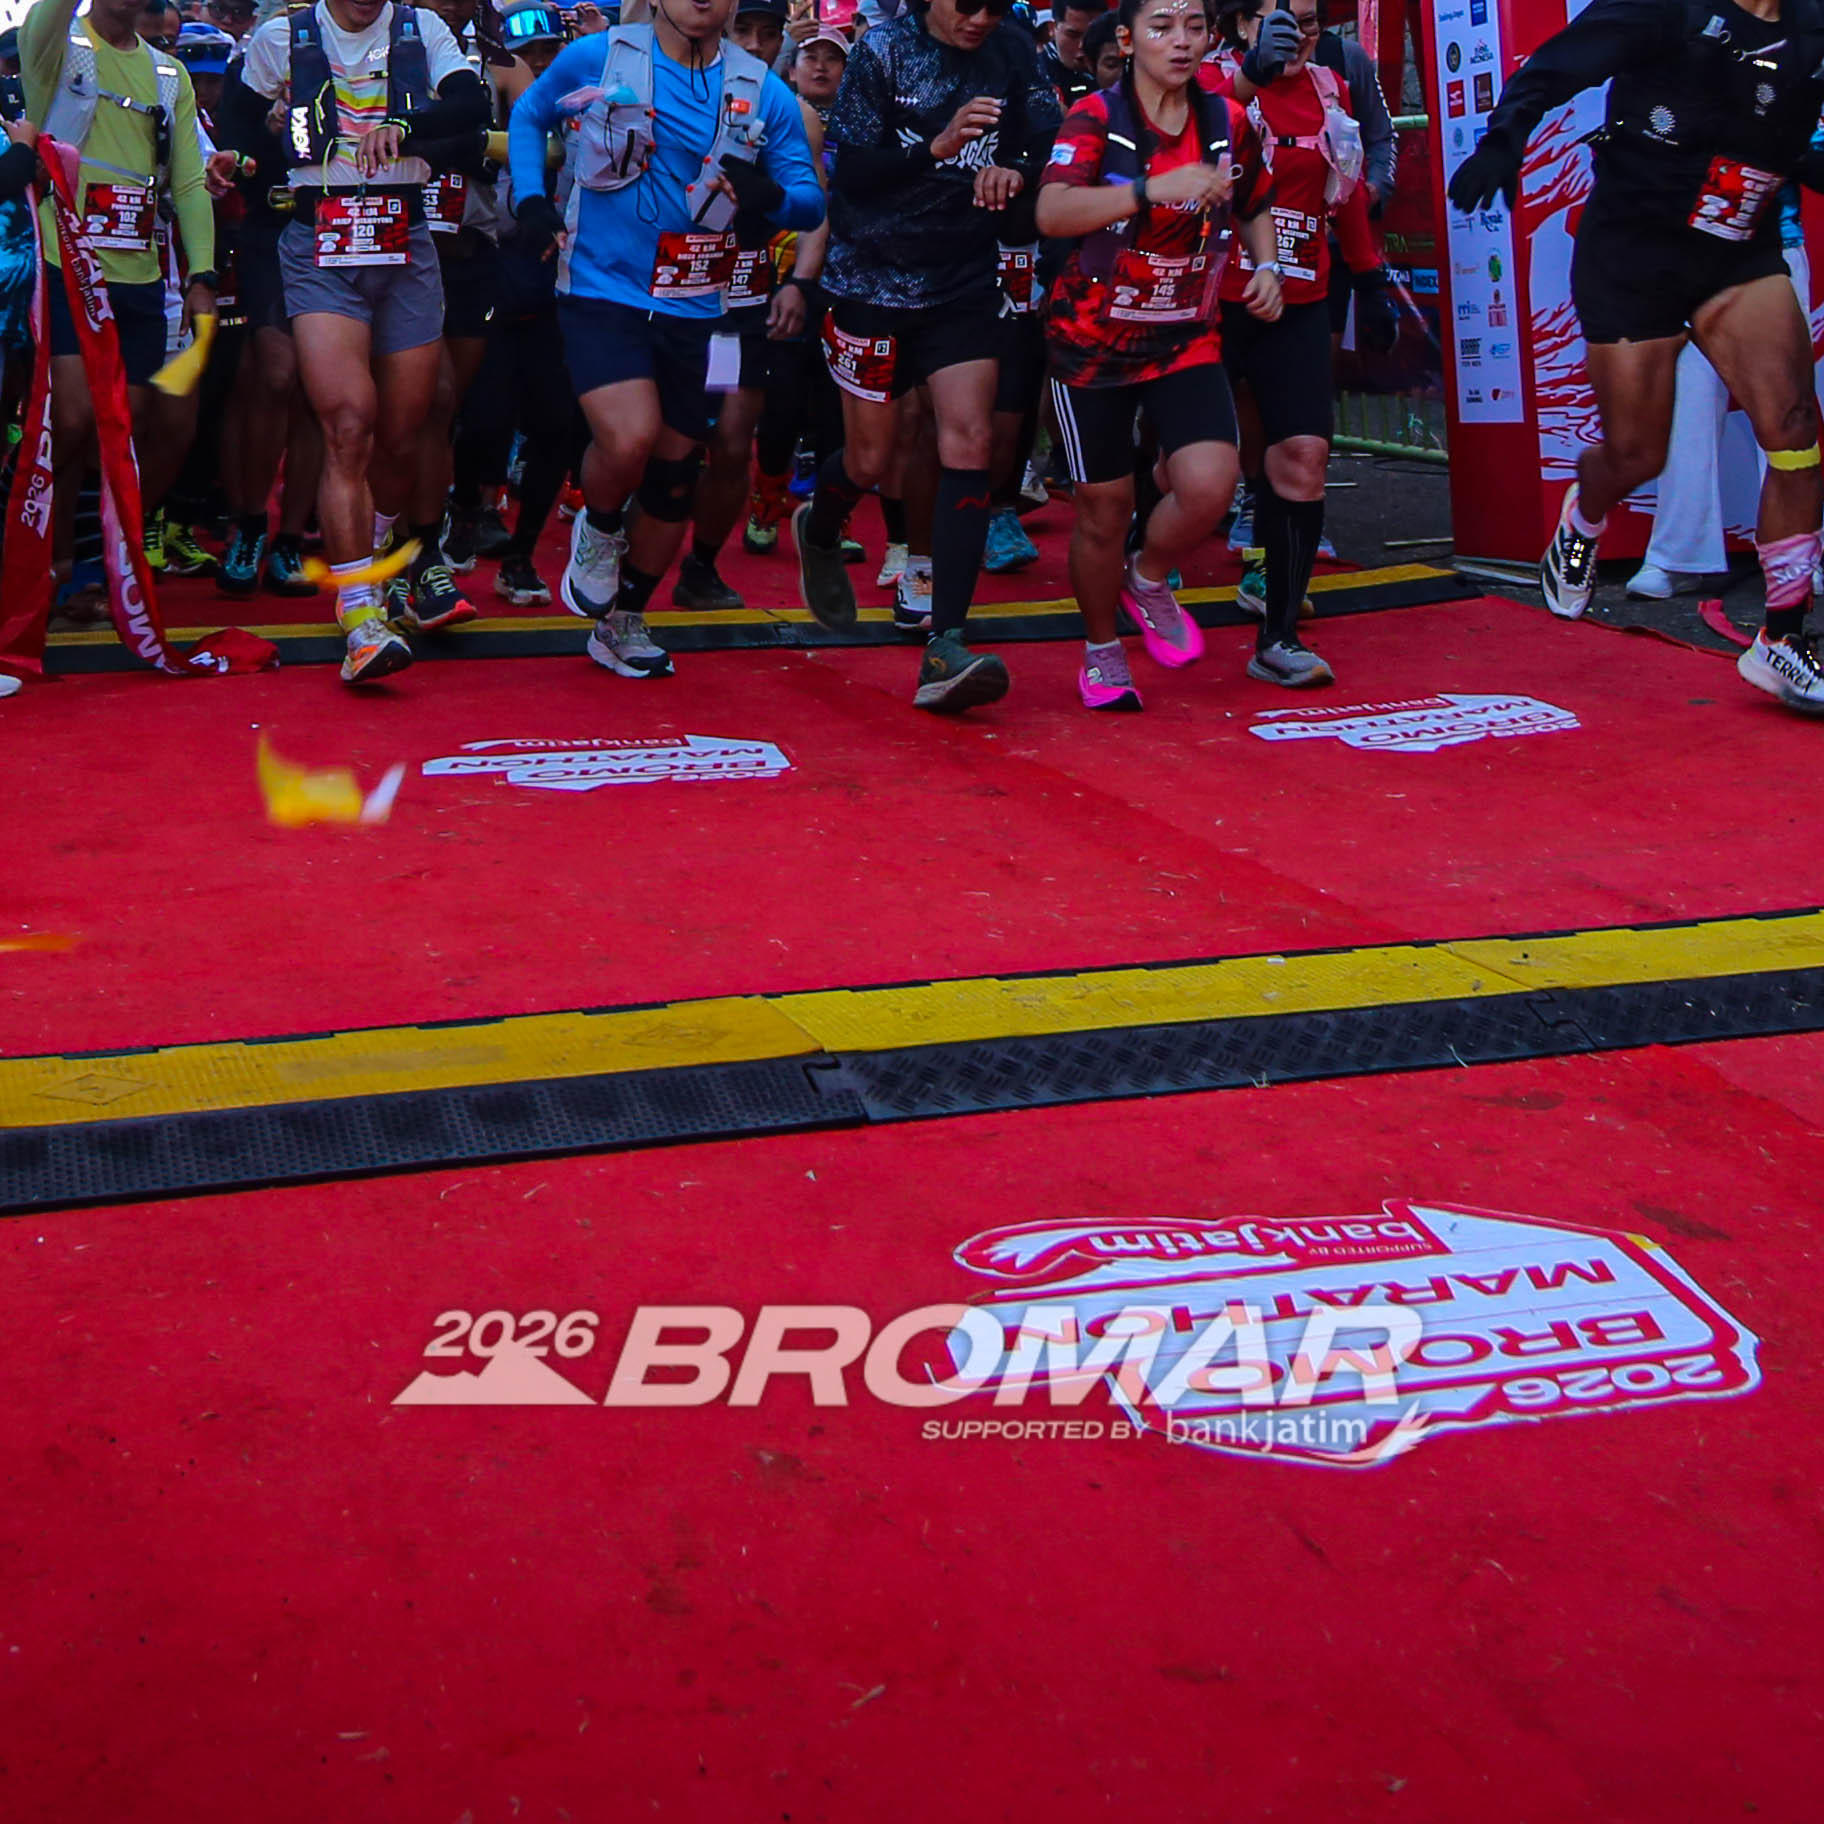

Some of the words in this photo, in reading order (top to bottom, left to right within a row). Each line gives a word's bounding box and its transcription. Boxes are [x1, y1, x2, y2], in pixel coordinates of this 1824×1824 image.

[119, 210, 137, 223] 102
[352, 225, 375, 238] 120
[1277, 234, 1296, 249] 267
[690, 260, 710, 272] 152
[732, 274, 748, 285] 147
[1152, 284, 1176, 296] 145
[837, 353, 857, 371] 261
[1275, 701, 1532, 735] MARATHON
[1358, 712, 1556, 743] BROMO
[448, 748, 764, 770] MARATHON
[527, 761, 767, 779] BROMO
[1089, 1215, 1423, 1257] bankjatim
[996, 1254, 1615, 1352] MARATHON
[1180, 1306, 1668, 1392] BROMO
[1488, 1353, 1726, 1406] 2026
